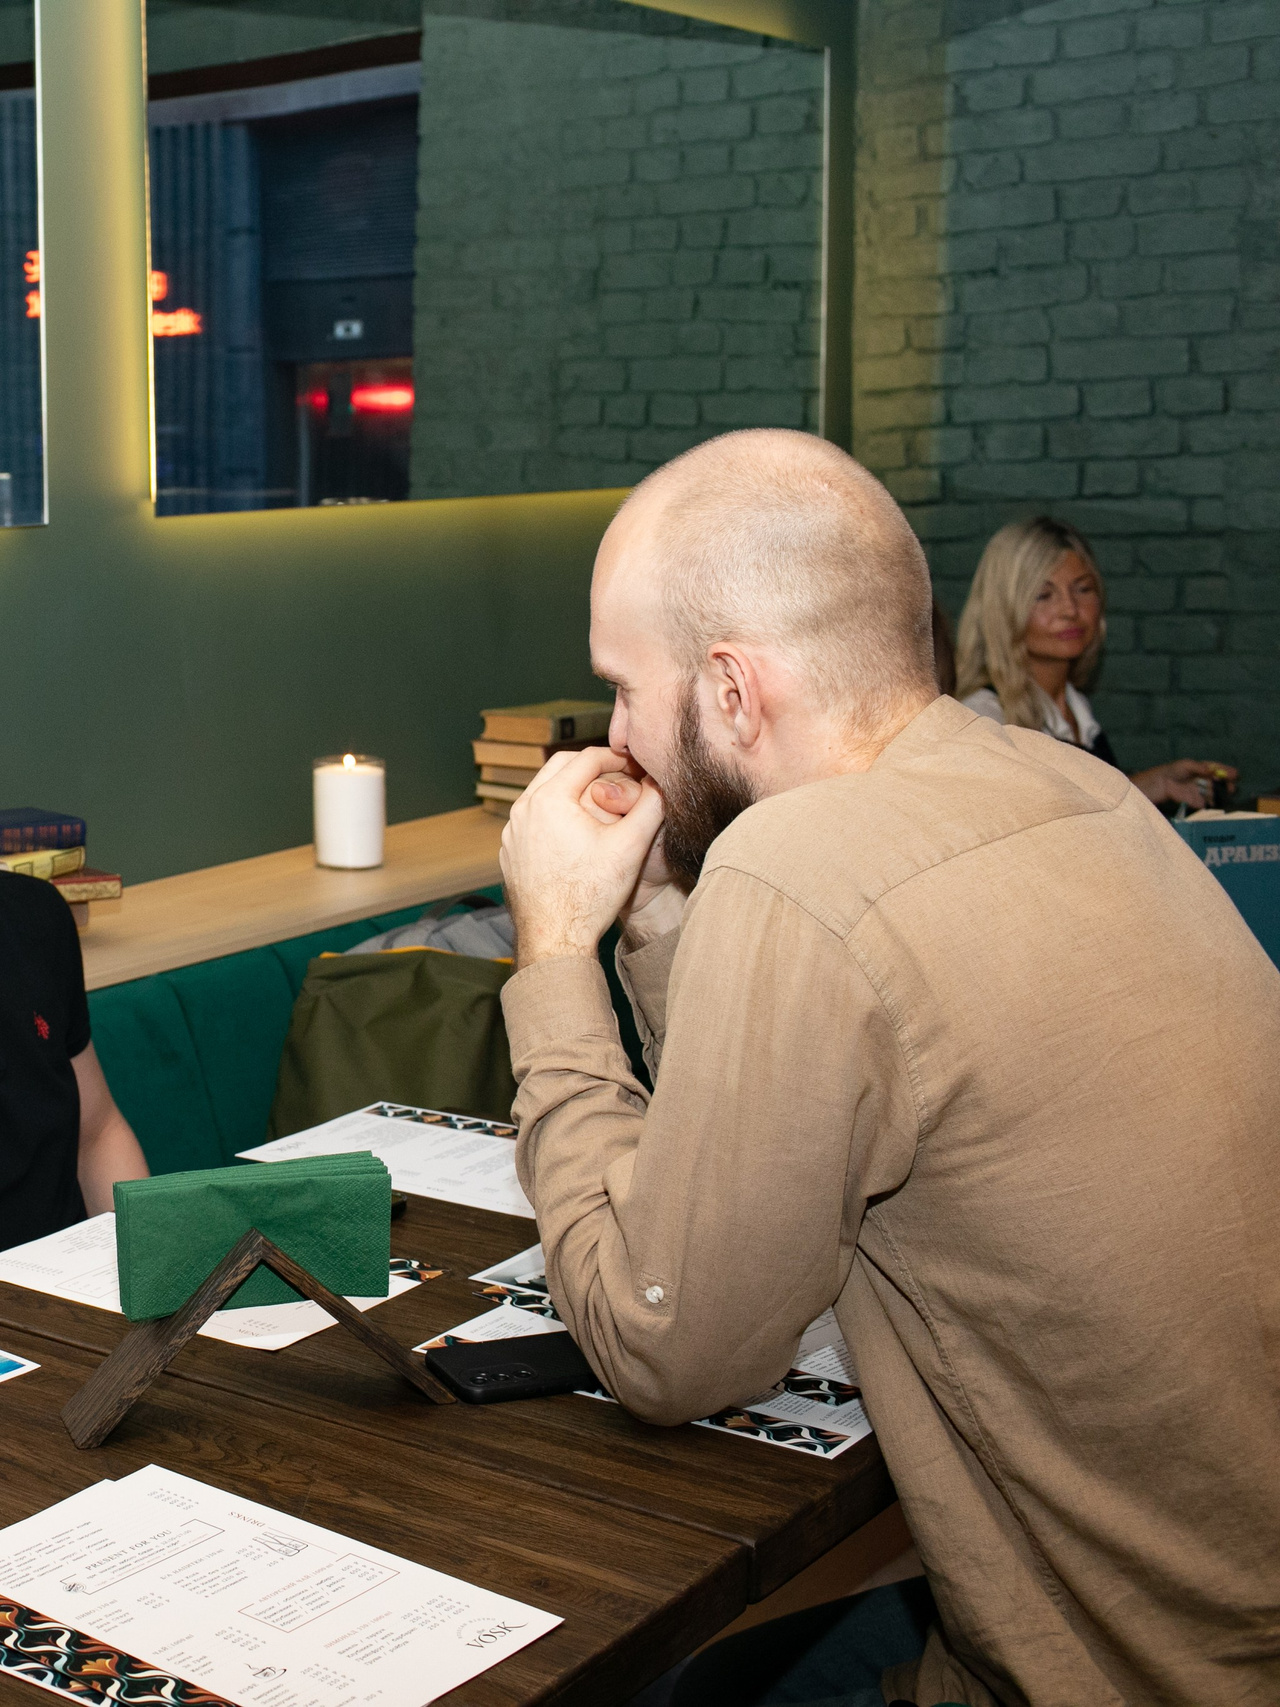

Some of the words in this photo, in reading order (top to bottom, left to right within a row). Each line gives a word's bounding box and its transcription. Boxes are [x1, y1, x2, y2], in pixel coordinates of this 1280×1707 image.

[228, 1512, 266, 1527] DRINKS
[85, 1550, 128, 1571] PRESENT
[129, 1540, 151, 1551] FOR
[149, 1530, 172, 1540] YOU
[465, 1621, 528, 1648] VOSK
